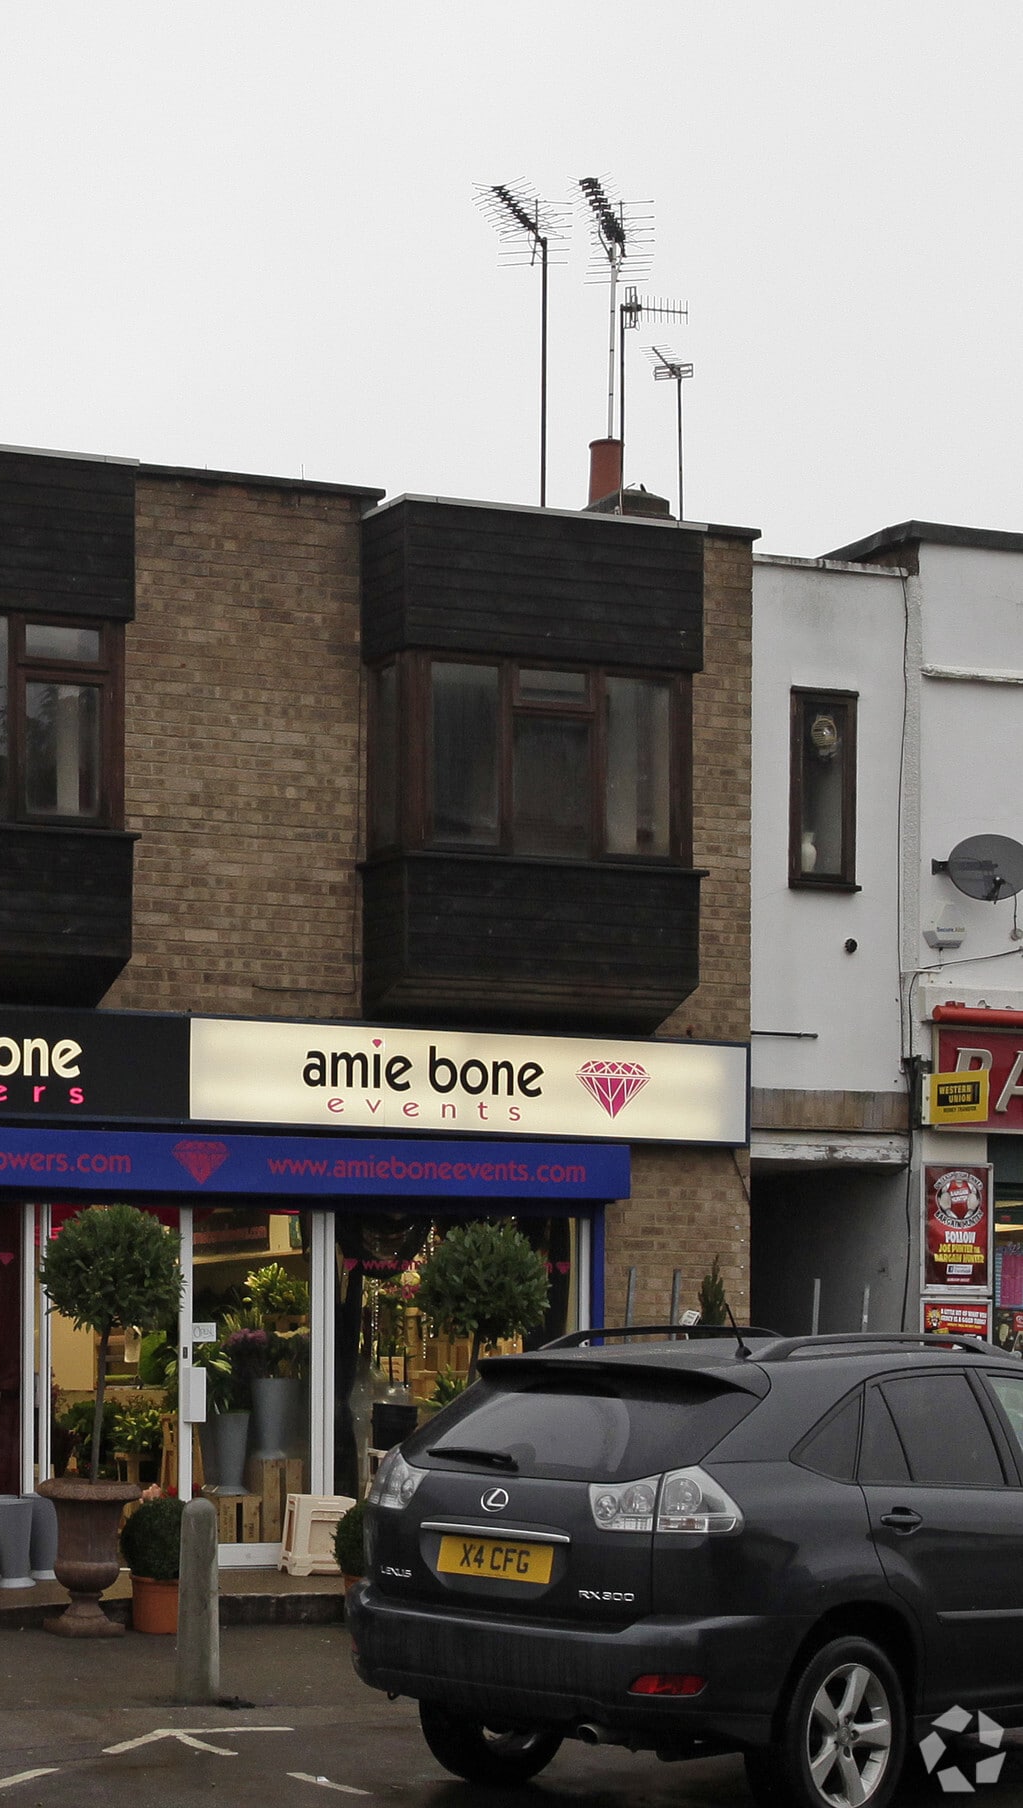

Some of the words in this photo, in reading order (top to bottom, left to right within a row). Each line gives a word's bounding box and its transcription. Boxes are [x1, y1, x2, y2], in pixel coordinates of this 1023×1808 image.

[302, 1038, 412, 1092] amie
[428, 1046, 544, 1098] bone
[938, 1084, 972, 1094] WESTERN
[948, 1094, 972, 1104] UNION
[327, 1095, 522, 1122] events
[267, 1154, 587, 1184] www.amieboneevents.com
[944, 1231, 976, 1244] FOLLOW
[460, 1543, 484, 1569] X4
[490, 1547, 530, 1574] CFG
[380, 1565, 413, 1578] LEXUS
